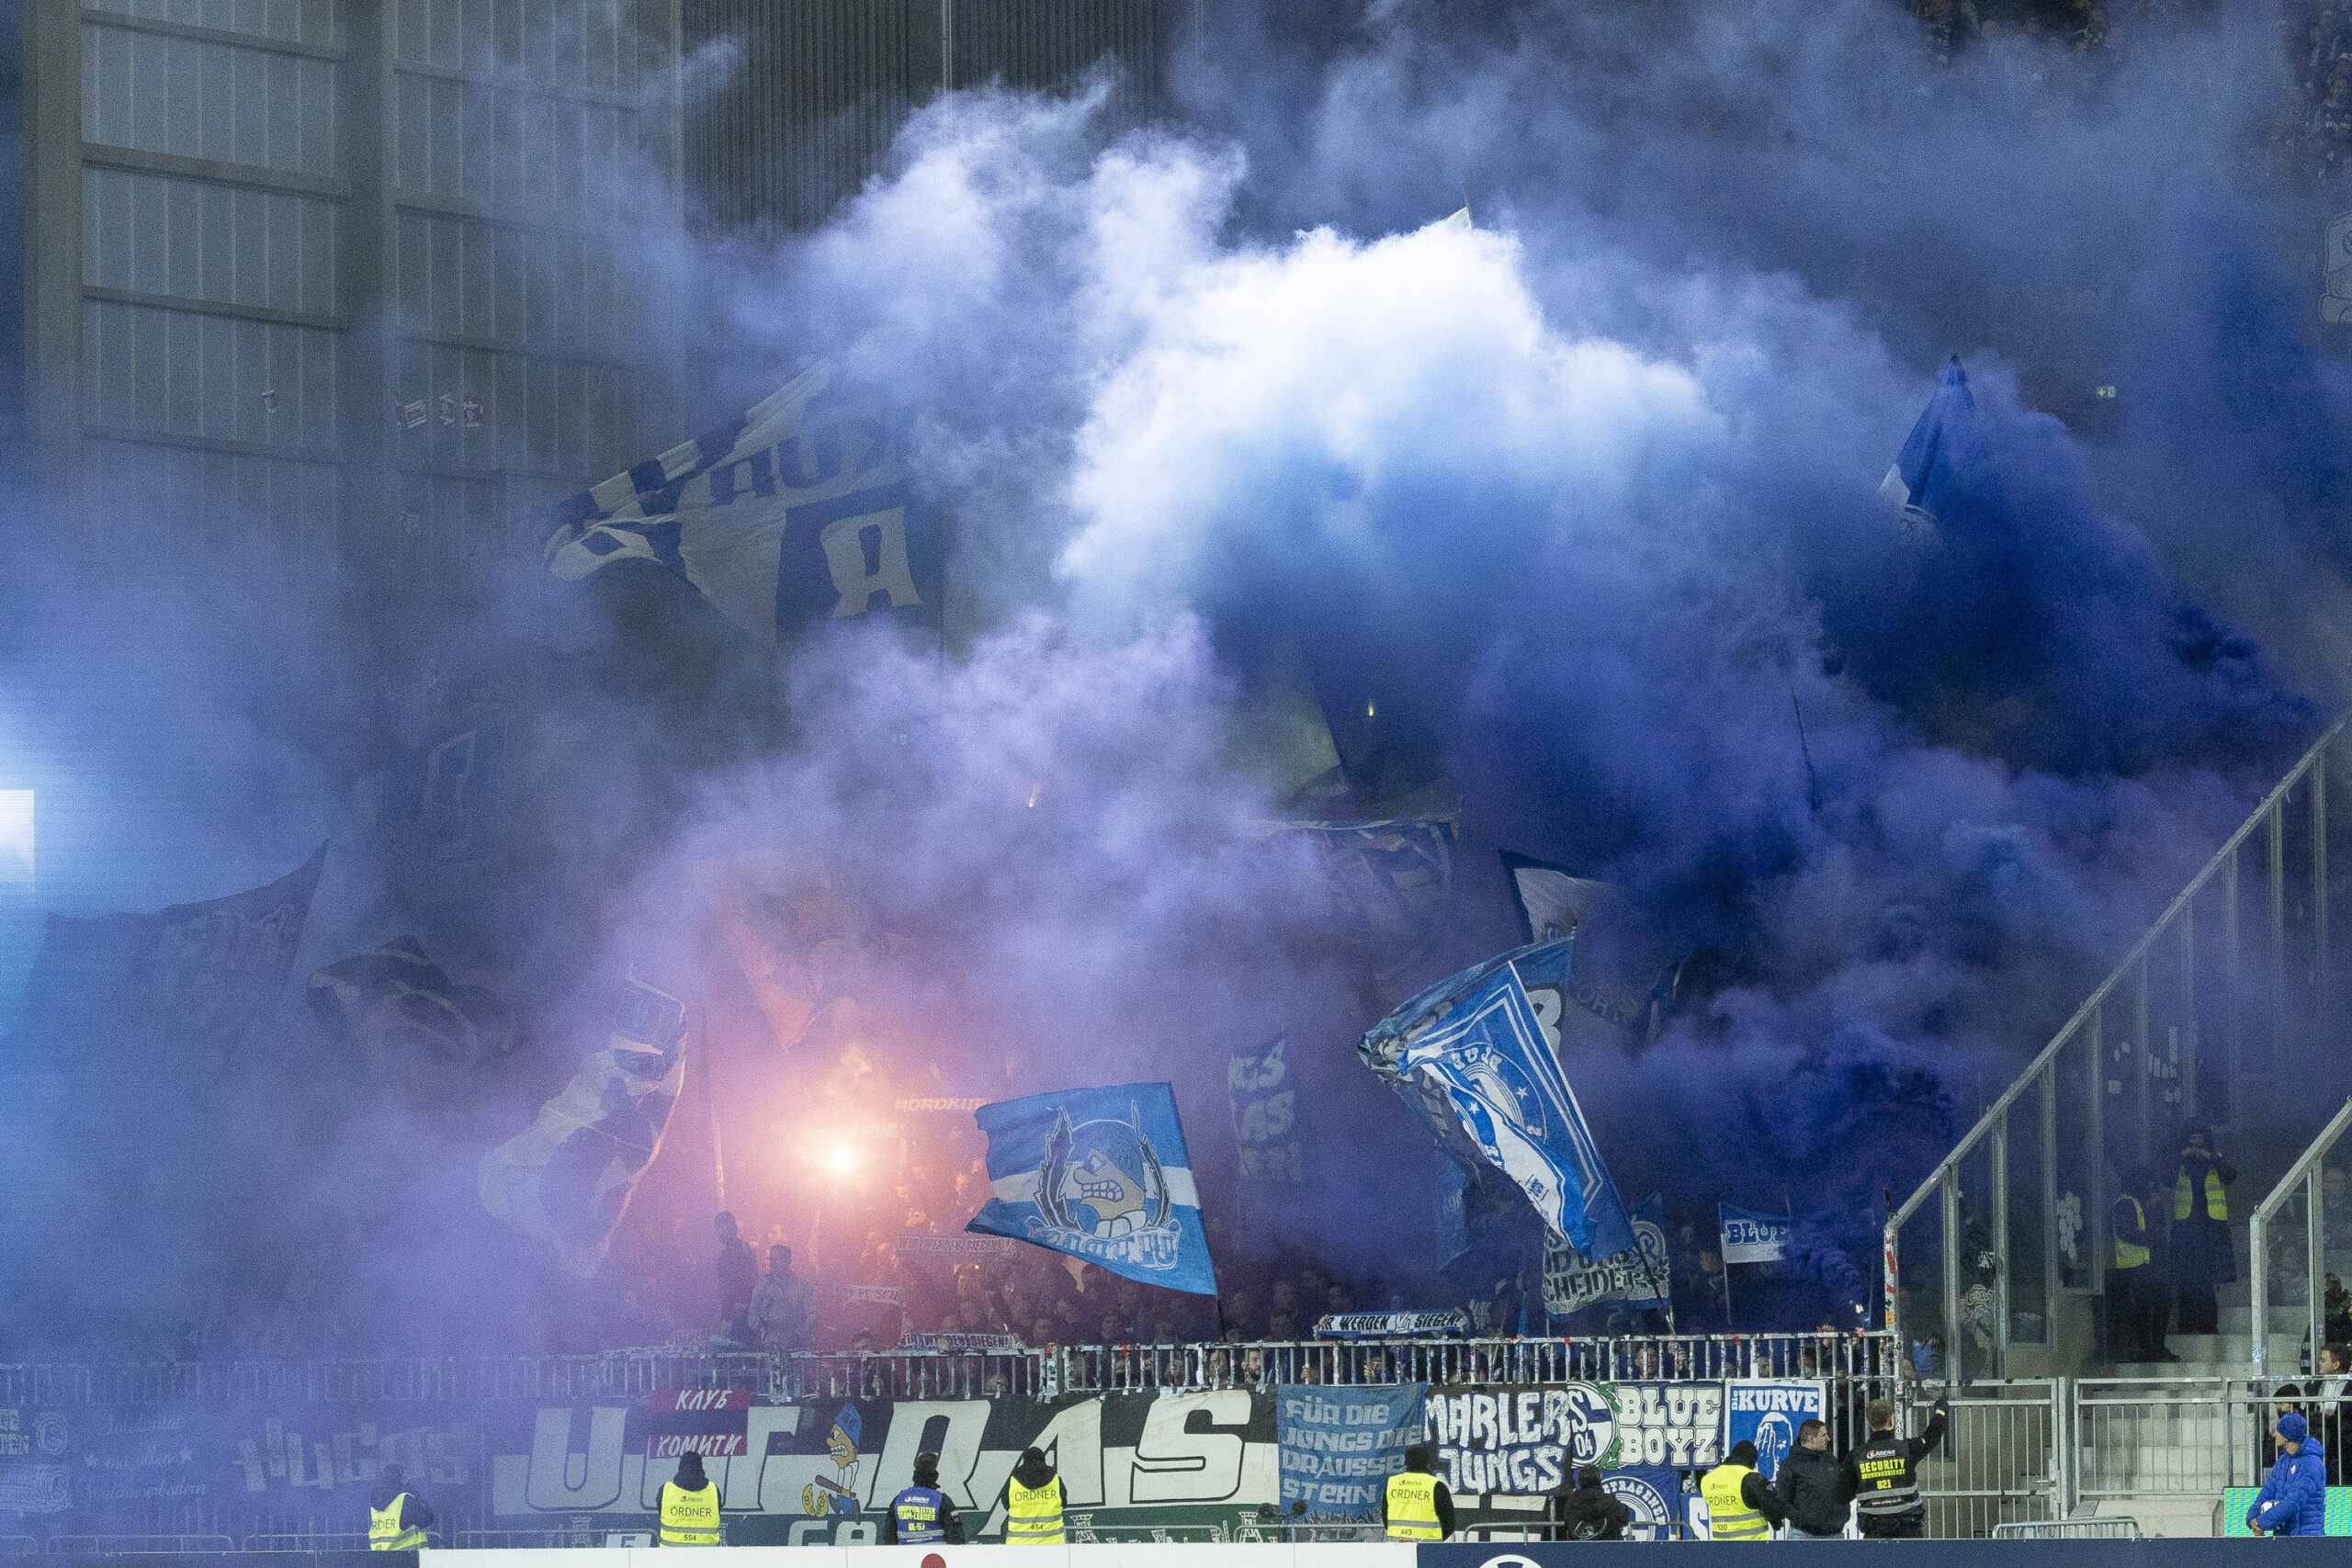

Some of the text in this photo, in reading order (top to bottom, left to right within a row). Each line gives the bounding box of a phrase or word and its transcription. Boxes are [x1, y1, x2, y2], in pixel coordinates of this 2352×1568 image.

[1340, 1315, 1391, 1331] WERDEN
[1415, 1313, 1461, 1328] SIEGEN!
[967, 1335, 1009, 1349] SIEGEN!
[674, 1389, 733, 1411] КЛУБ
[1286, 1395, 1340, 1426] FÜR
[1617, 1385, 1723, 1427] BLUE
[1738, 1390, 1818, 1413] KURVE
[1424, 1390, 1570, 1447] MARLER
[655, 1434, 743, 1459] КОМИТИ
[1282, 1427, 1373, 1452] JUNGS
[1618, 1427, 1720, 1466] BOYZ
[1437, 1446, 1566, 1495] JUNGS
[1859, 1458, 1905, 1473] SECURITY
[1014, 1489, 1057, 1502] ORDNER
[1390, 1488, 1430, 1502] ORDNER
[1876, 1479, 1892, 1490] 821
[670, 1506, 712, 1517] ORDNER
